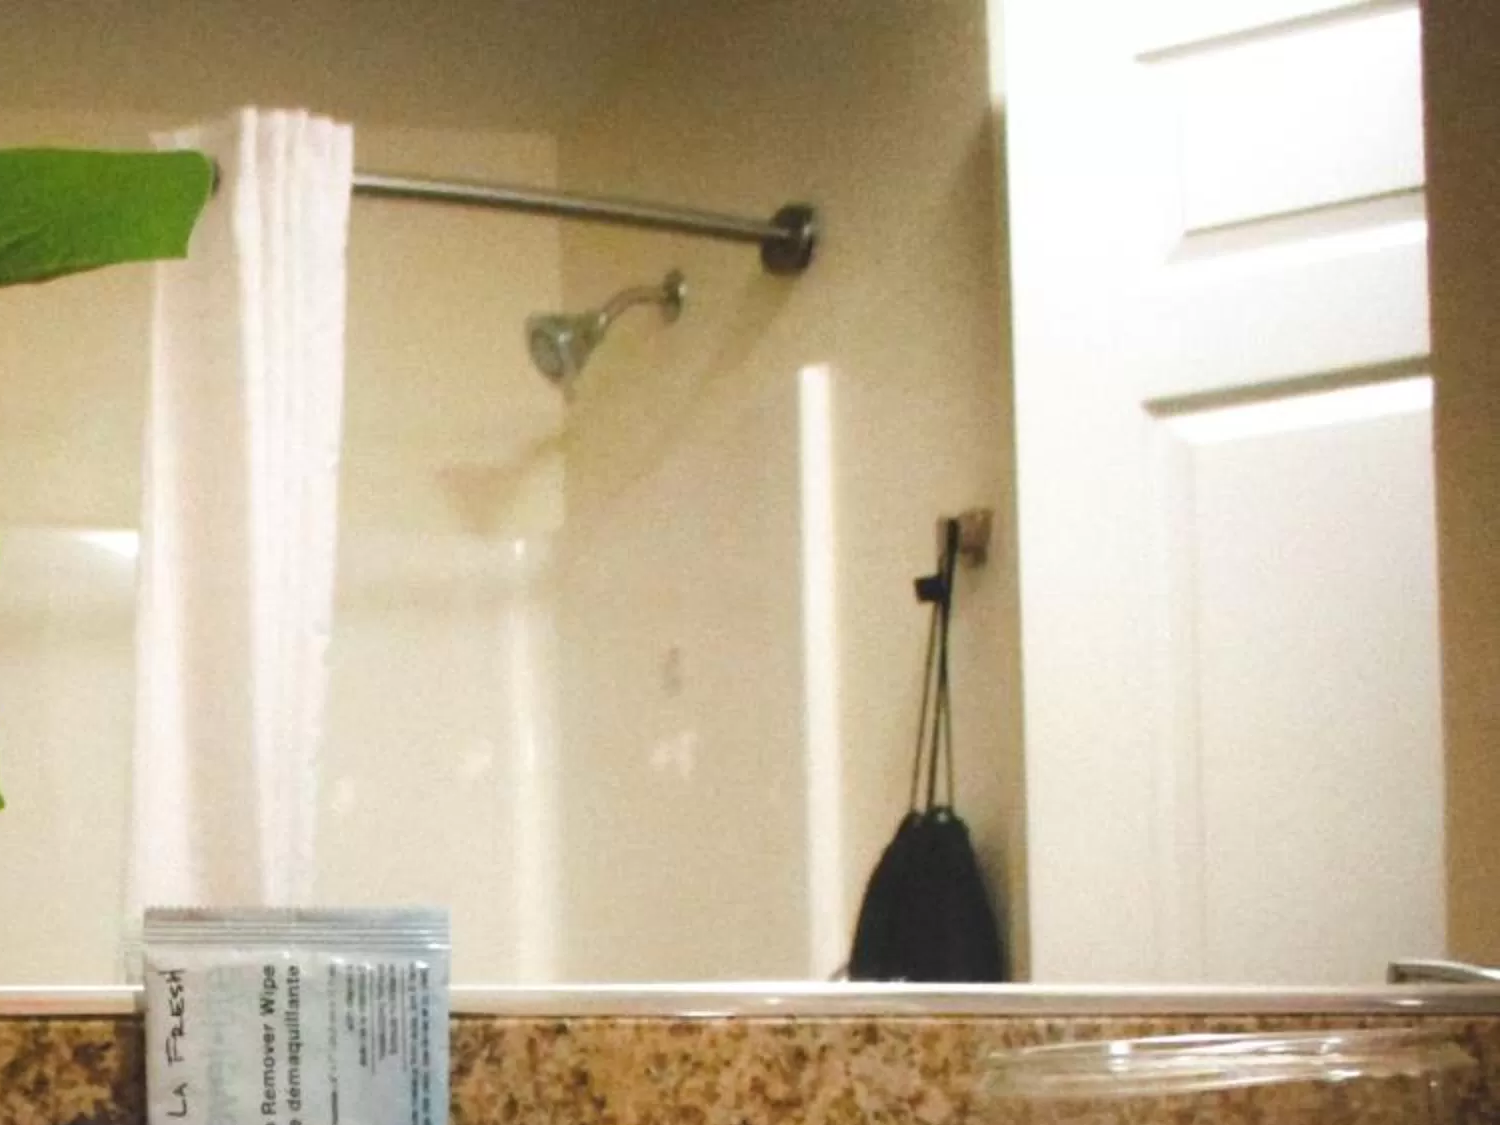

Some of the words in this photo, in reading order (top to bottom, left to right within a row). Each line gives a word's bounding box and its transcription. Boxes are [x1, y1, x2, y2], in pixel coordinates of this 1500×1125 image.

[158, 969, 187, 1067] FRESH
[260, 964, 279, 1017] Wipe
[167, 1082, 188, 1118] LA
[261, 1023, 277, 1116] Remover
